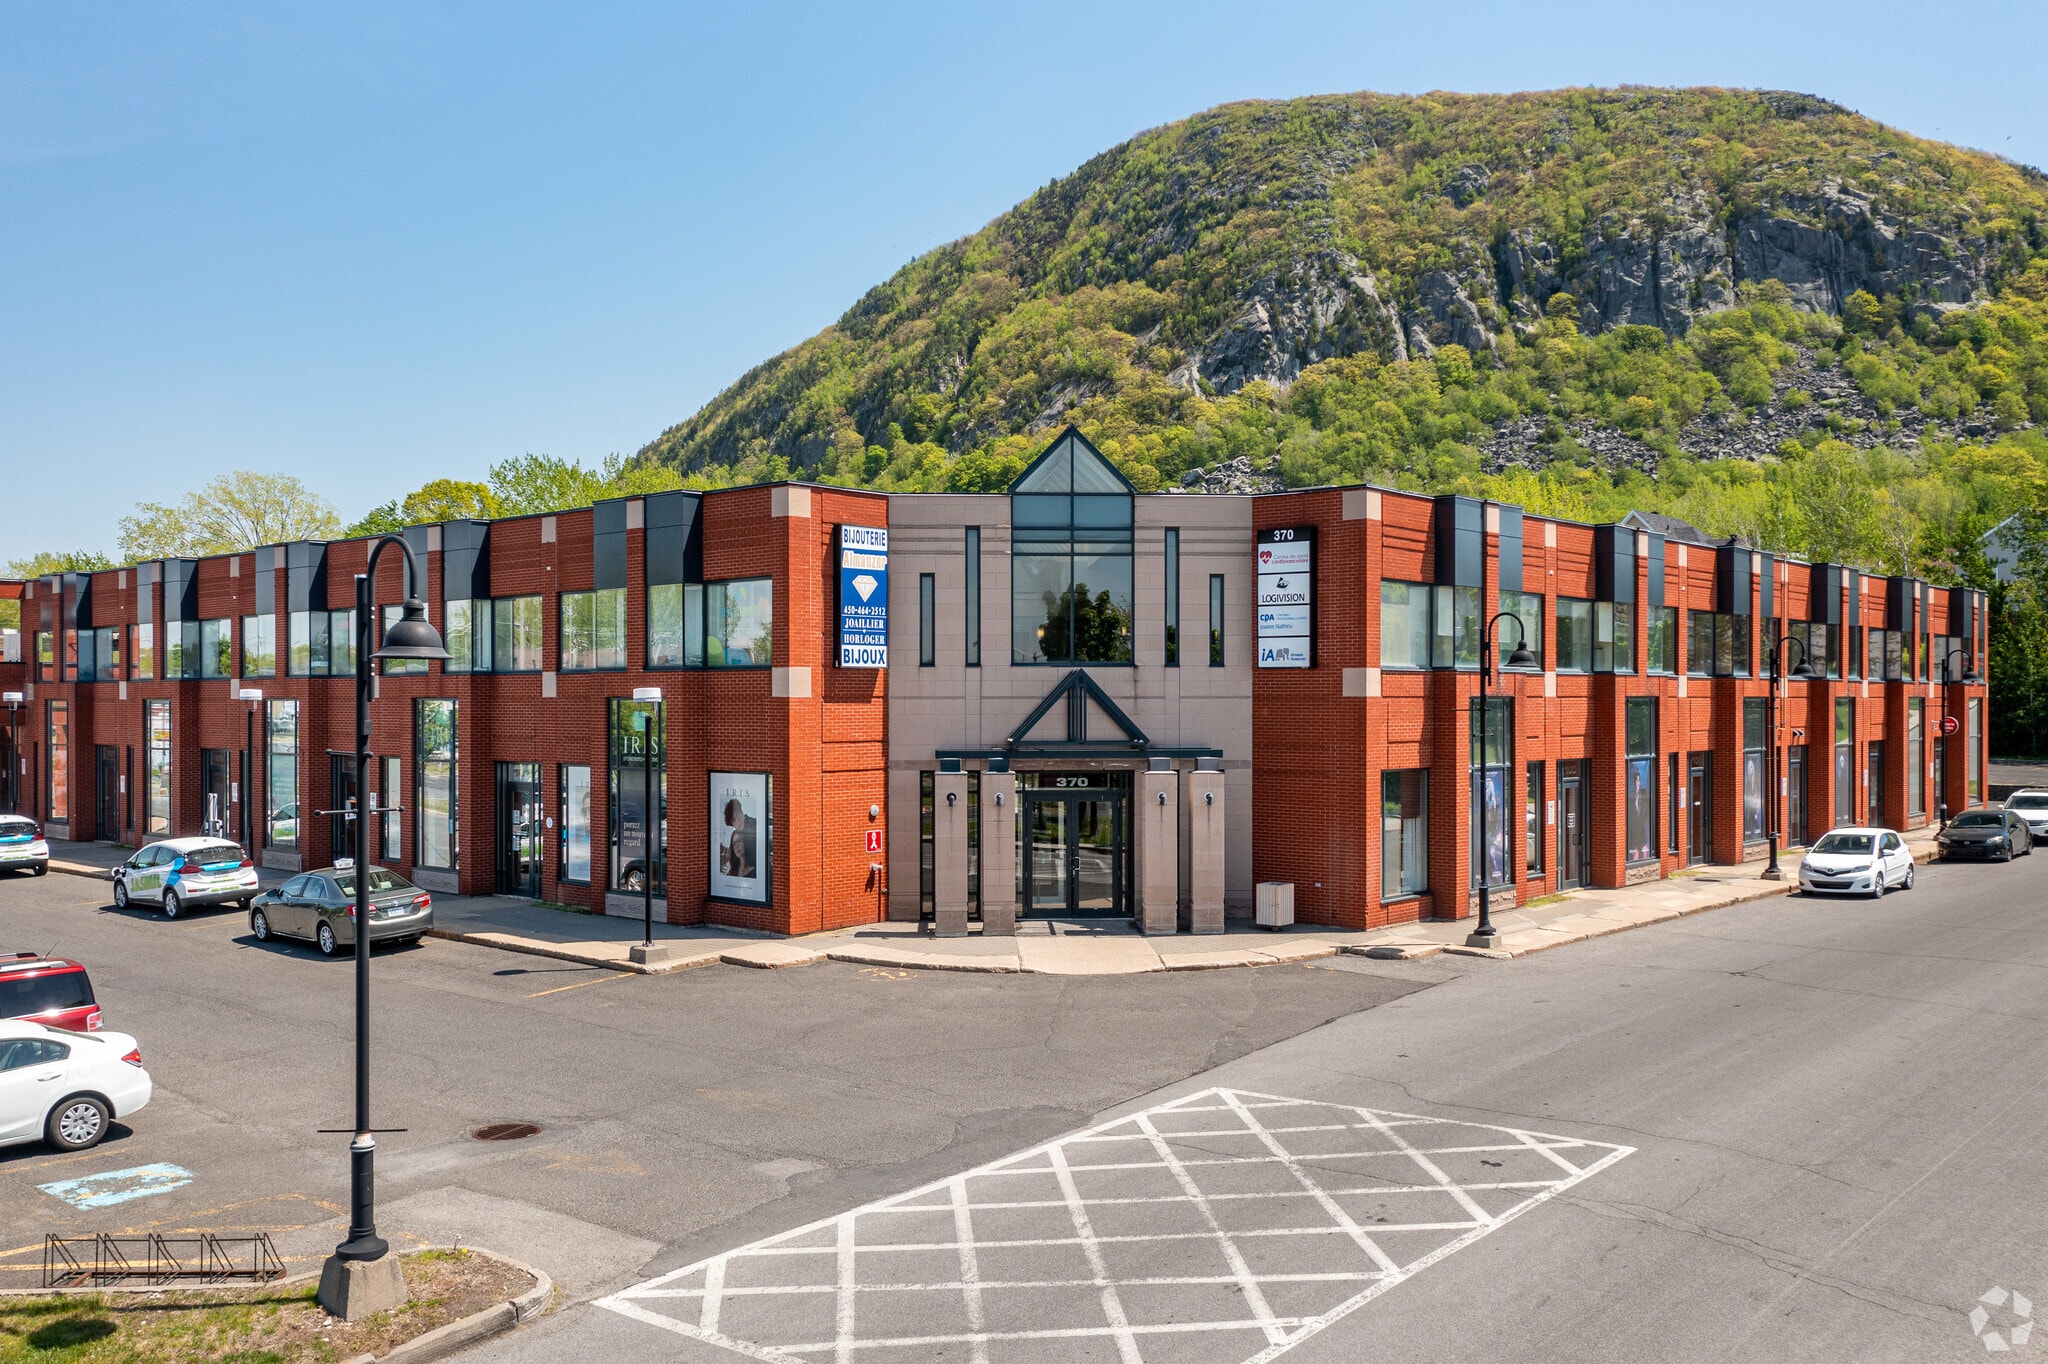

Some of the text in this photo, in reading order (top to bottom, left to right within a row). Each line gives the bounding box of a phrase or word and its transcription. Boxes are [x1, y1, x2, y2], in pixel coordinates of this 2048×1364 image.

[843, 528, 886, 547] BIJOUTERIE
[1273, 529, 1294, 541] 370
[843, 551, 886, 570] Almanzor
[1261, 593, 1305, 603] LOGIVISION
[844, 618, 884, 629] JOAILLIER
[844, 633, 885, 645] HORLOGER
[843, 648, 886, 664] BIJOUX
[1056, 777, 1089, 787] 370
[726, 788, 751, 797] IRIS
